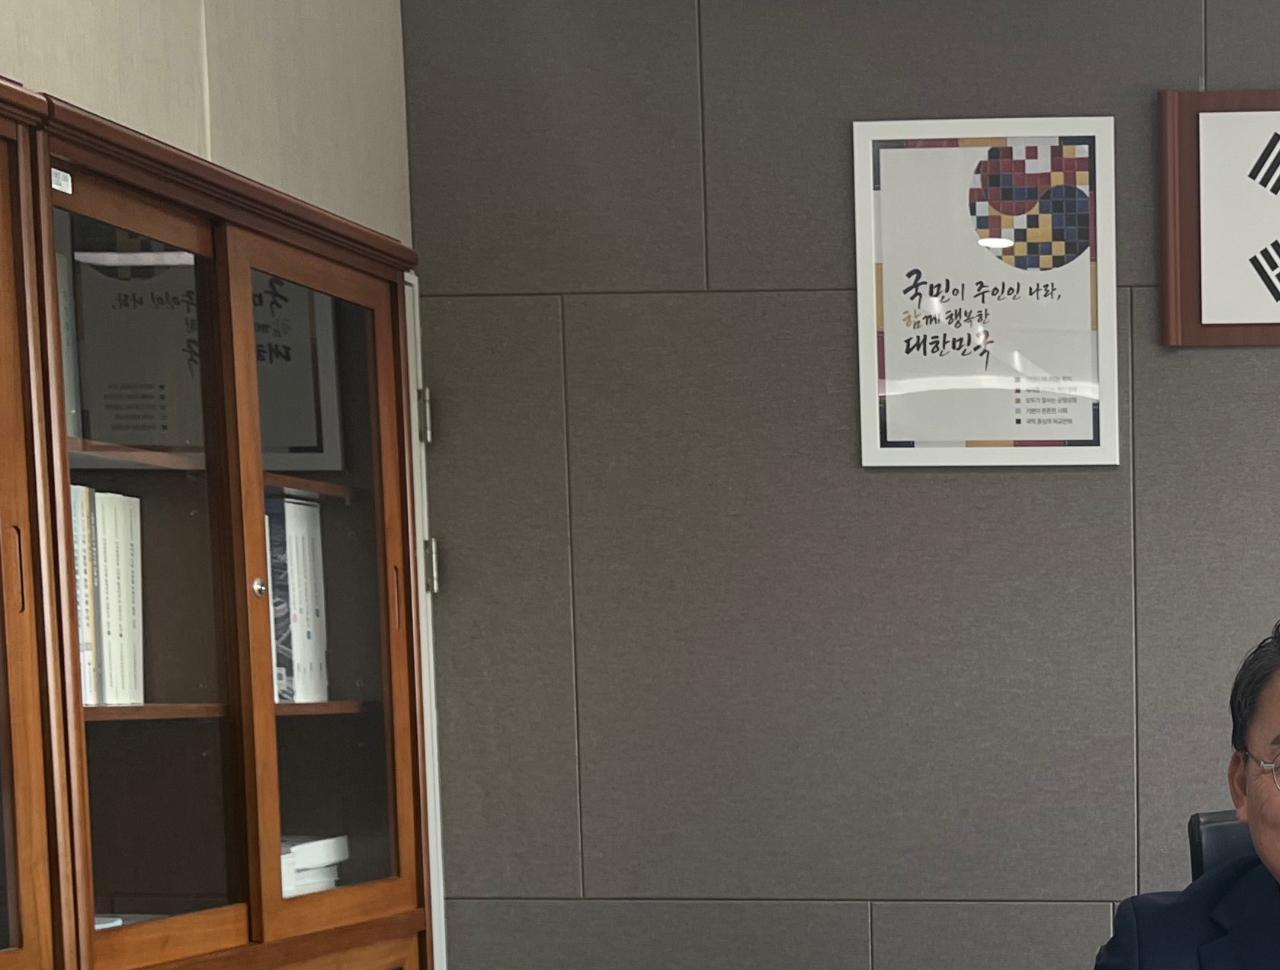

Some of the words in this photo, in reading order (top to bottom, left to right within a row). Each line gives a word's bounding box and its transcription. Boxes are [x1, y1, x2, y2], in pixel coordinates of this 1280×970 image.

[902, 268, 965, 309] 국민이
[973, 281, 1021, 305] 주인인
[1029, 282, 1062, 302] 나라,
[902, 309, 942, 330] 함께
[946, 309, 990, 326] 행복한
[904, 329, 994, 372] 대한민국
